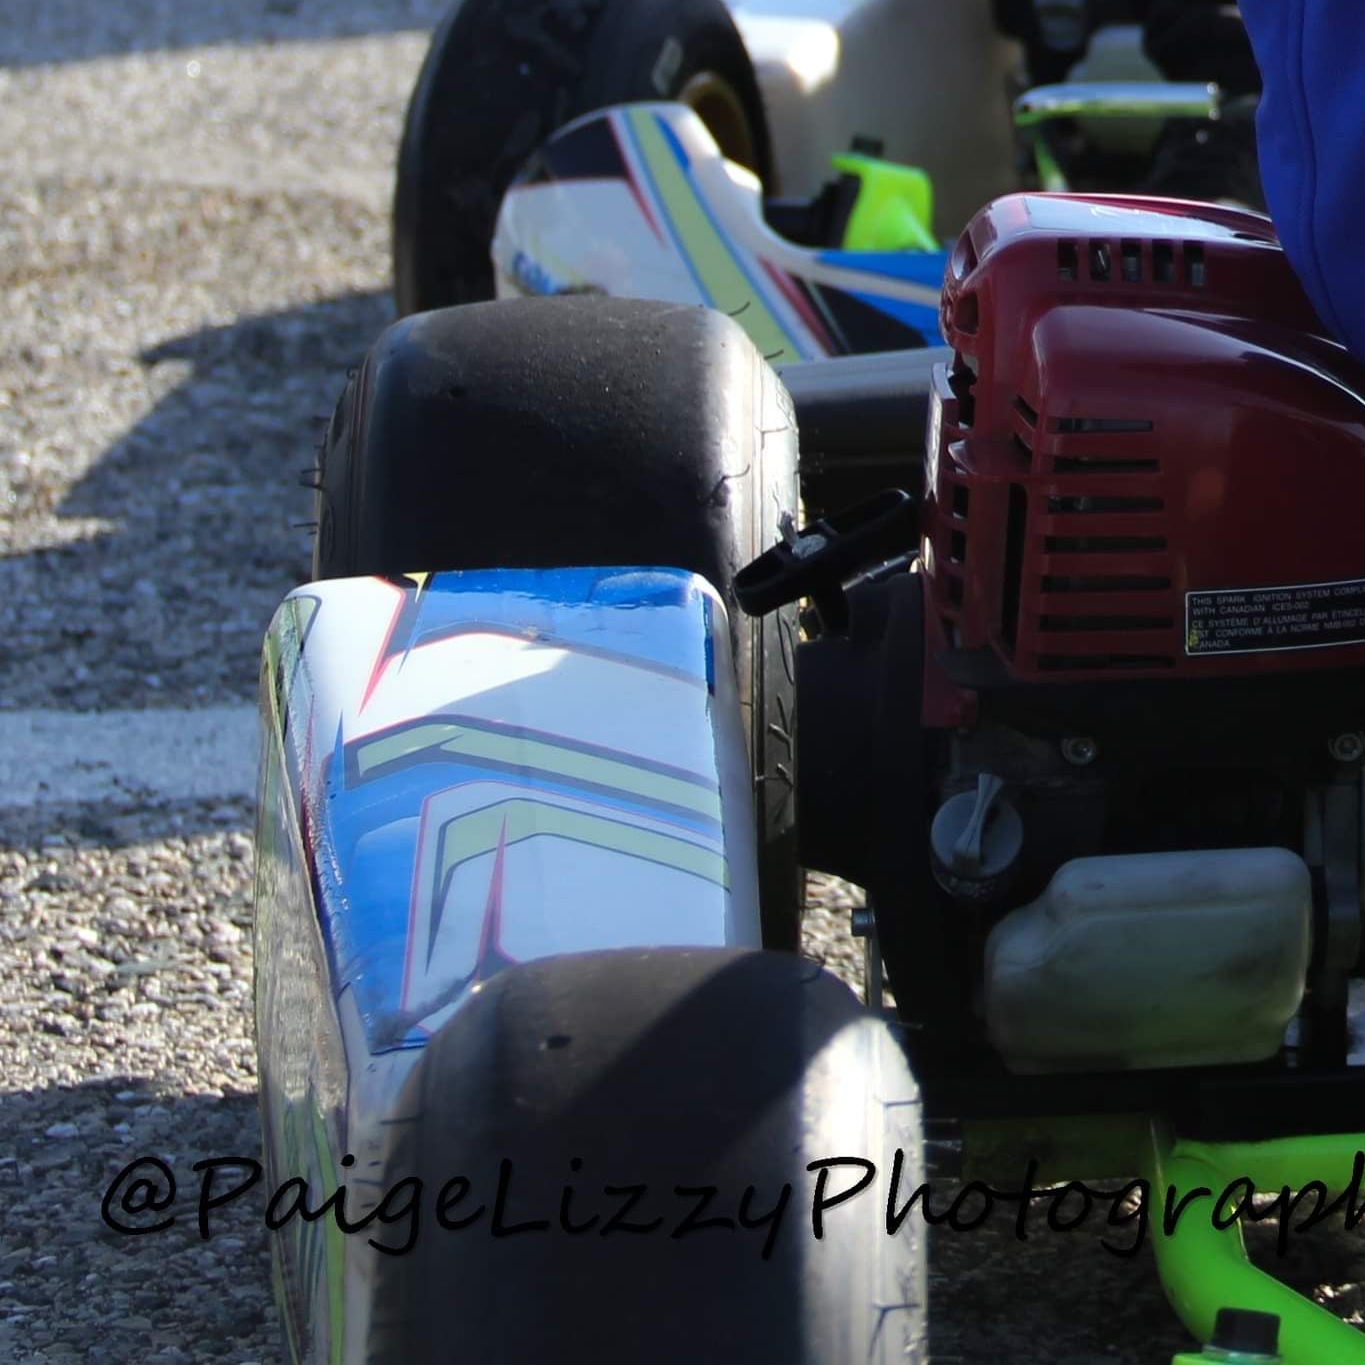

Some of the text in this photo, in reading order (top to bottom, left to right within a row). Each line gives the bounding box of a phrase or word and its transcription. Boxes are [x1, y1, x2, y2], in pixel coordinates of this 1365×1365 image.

[1216, 595, 1246, 604] SPARK
[1253, 593, 1292, 603] IGNITION
[1296, 589, 1330, 599] SYSTEM
[1192, 607, 1216, 616] WITH
[1219, 604, 1265, 614] CANADIAN
[1312, 611, 1328, 620] PAR
[1215, 627, 1264, 638] CONFORME
[1290, 623, 1320, 634] NORME
